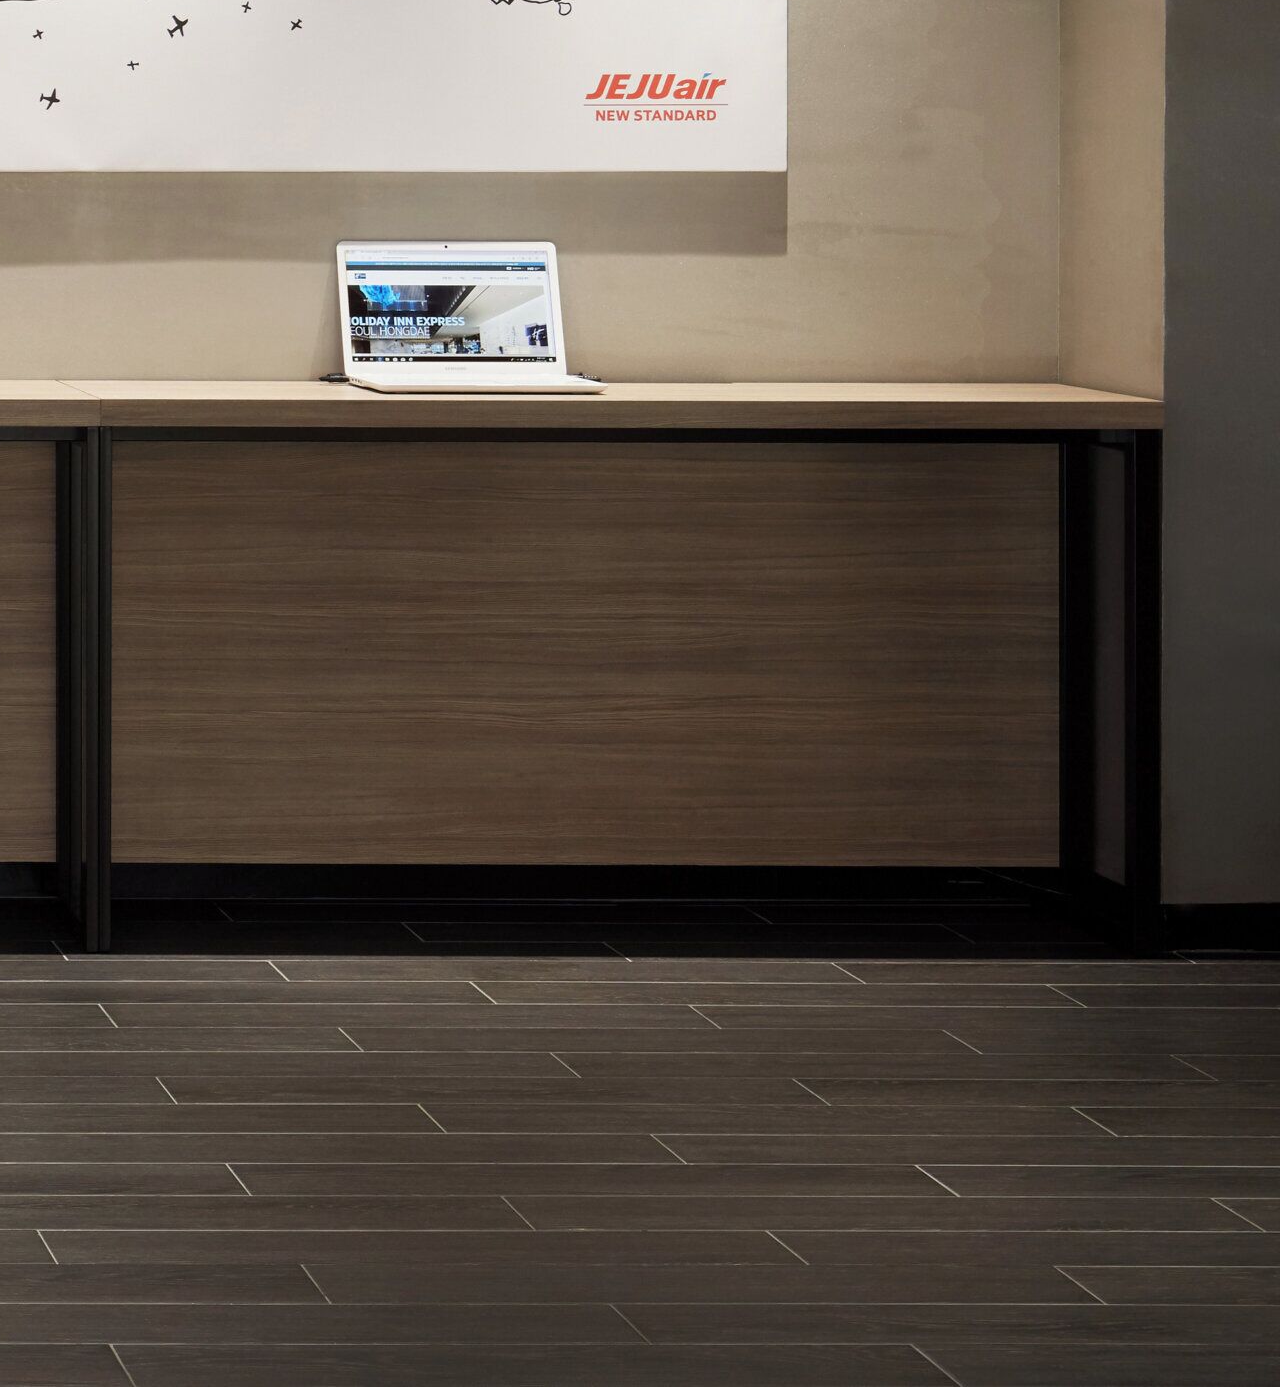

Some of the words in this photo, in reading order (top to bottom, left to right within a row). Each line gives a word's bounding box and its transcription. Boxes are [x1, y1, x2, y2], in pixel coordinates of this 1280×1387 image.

[585, 72, 727, 100] JEJUair
[596, 110, 629, 121] NEW
[634, 110, 716, 121] STANDARD
[350, 316, 390, 326] OLIDAY
[394, 317, 413, 326] INN
[417, 317, 465, 326] EXPRESS
[350, 326, 377, 336] EOUL
[380, 327, 430, 336] HONGDAE
